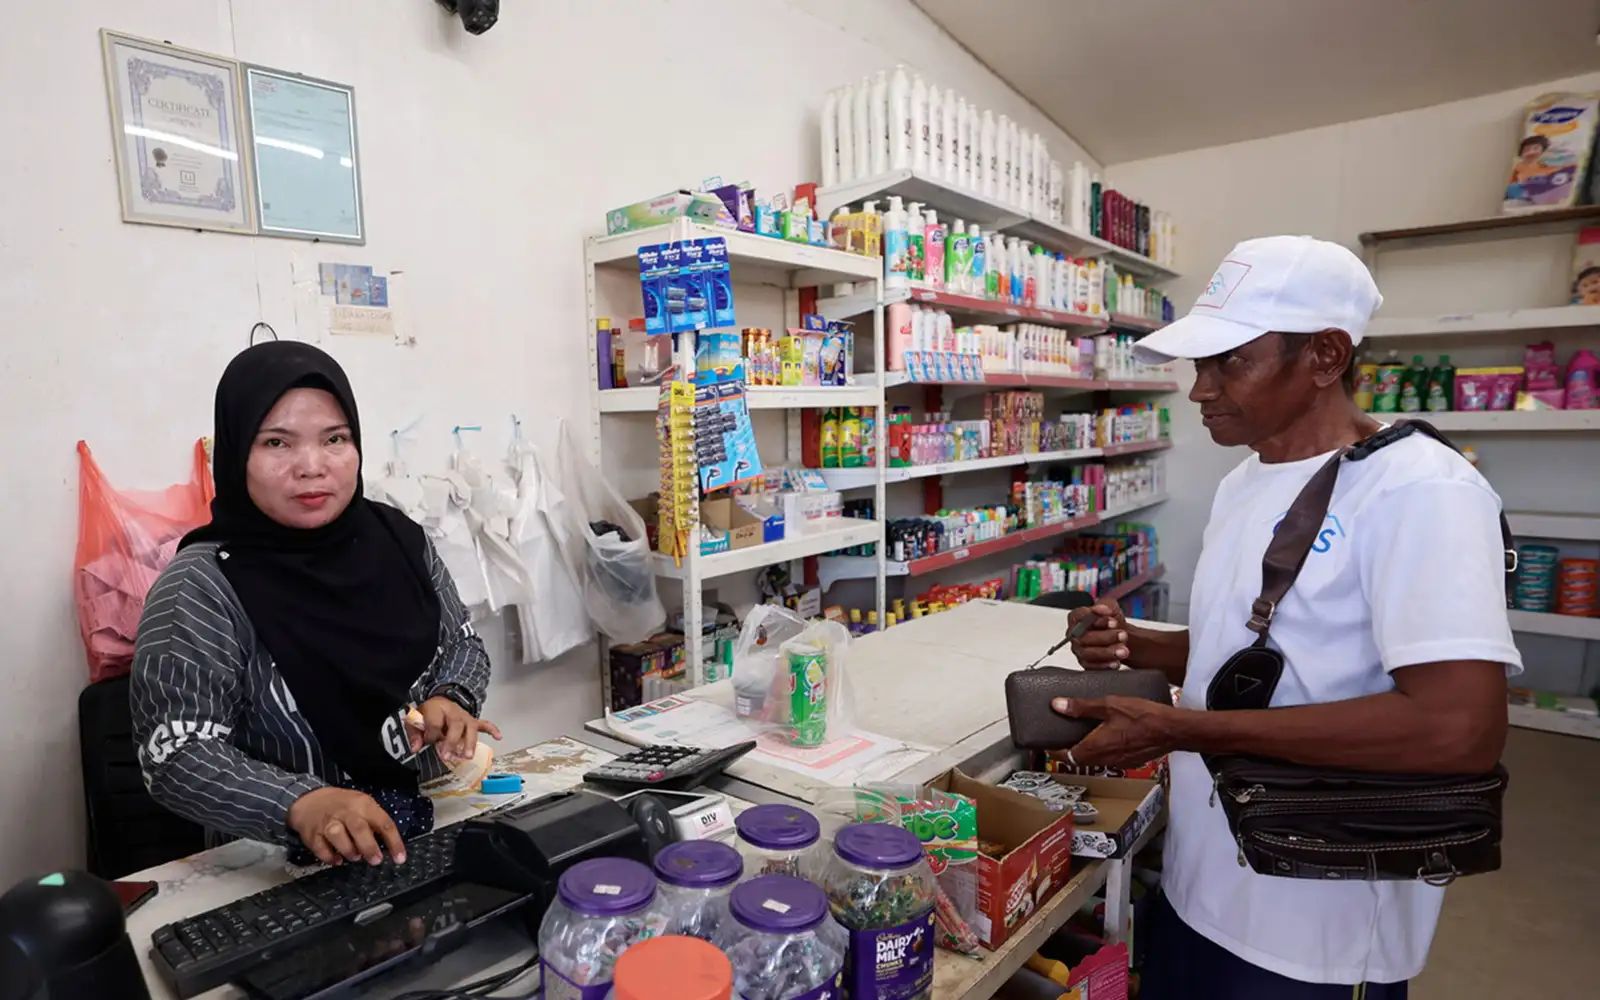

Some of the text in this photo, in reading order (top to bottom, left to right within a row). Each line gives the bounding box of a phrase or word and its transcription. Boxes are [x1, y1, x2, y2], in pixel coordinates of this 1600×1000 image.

[700, 811, 718, 825] DIV
[876, 932, 914, 953] DAIRY
[876, 947, 906, 964] MILK
